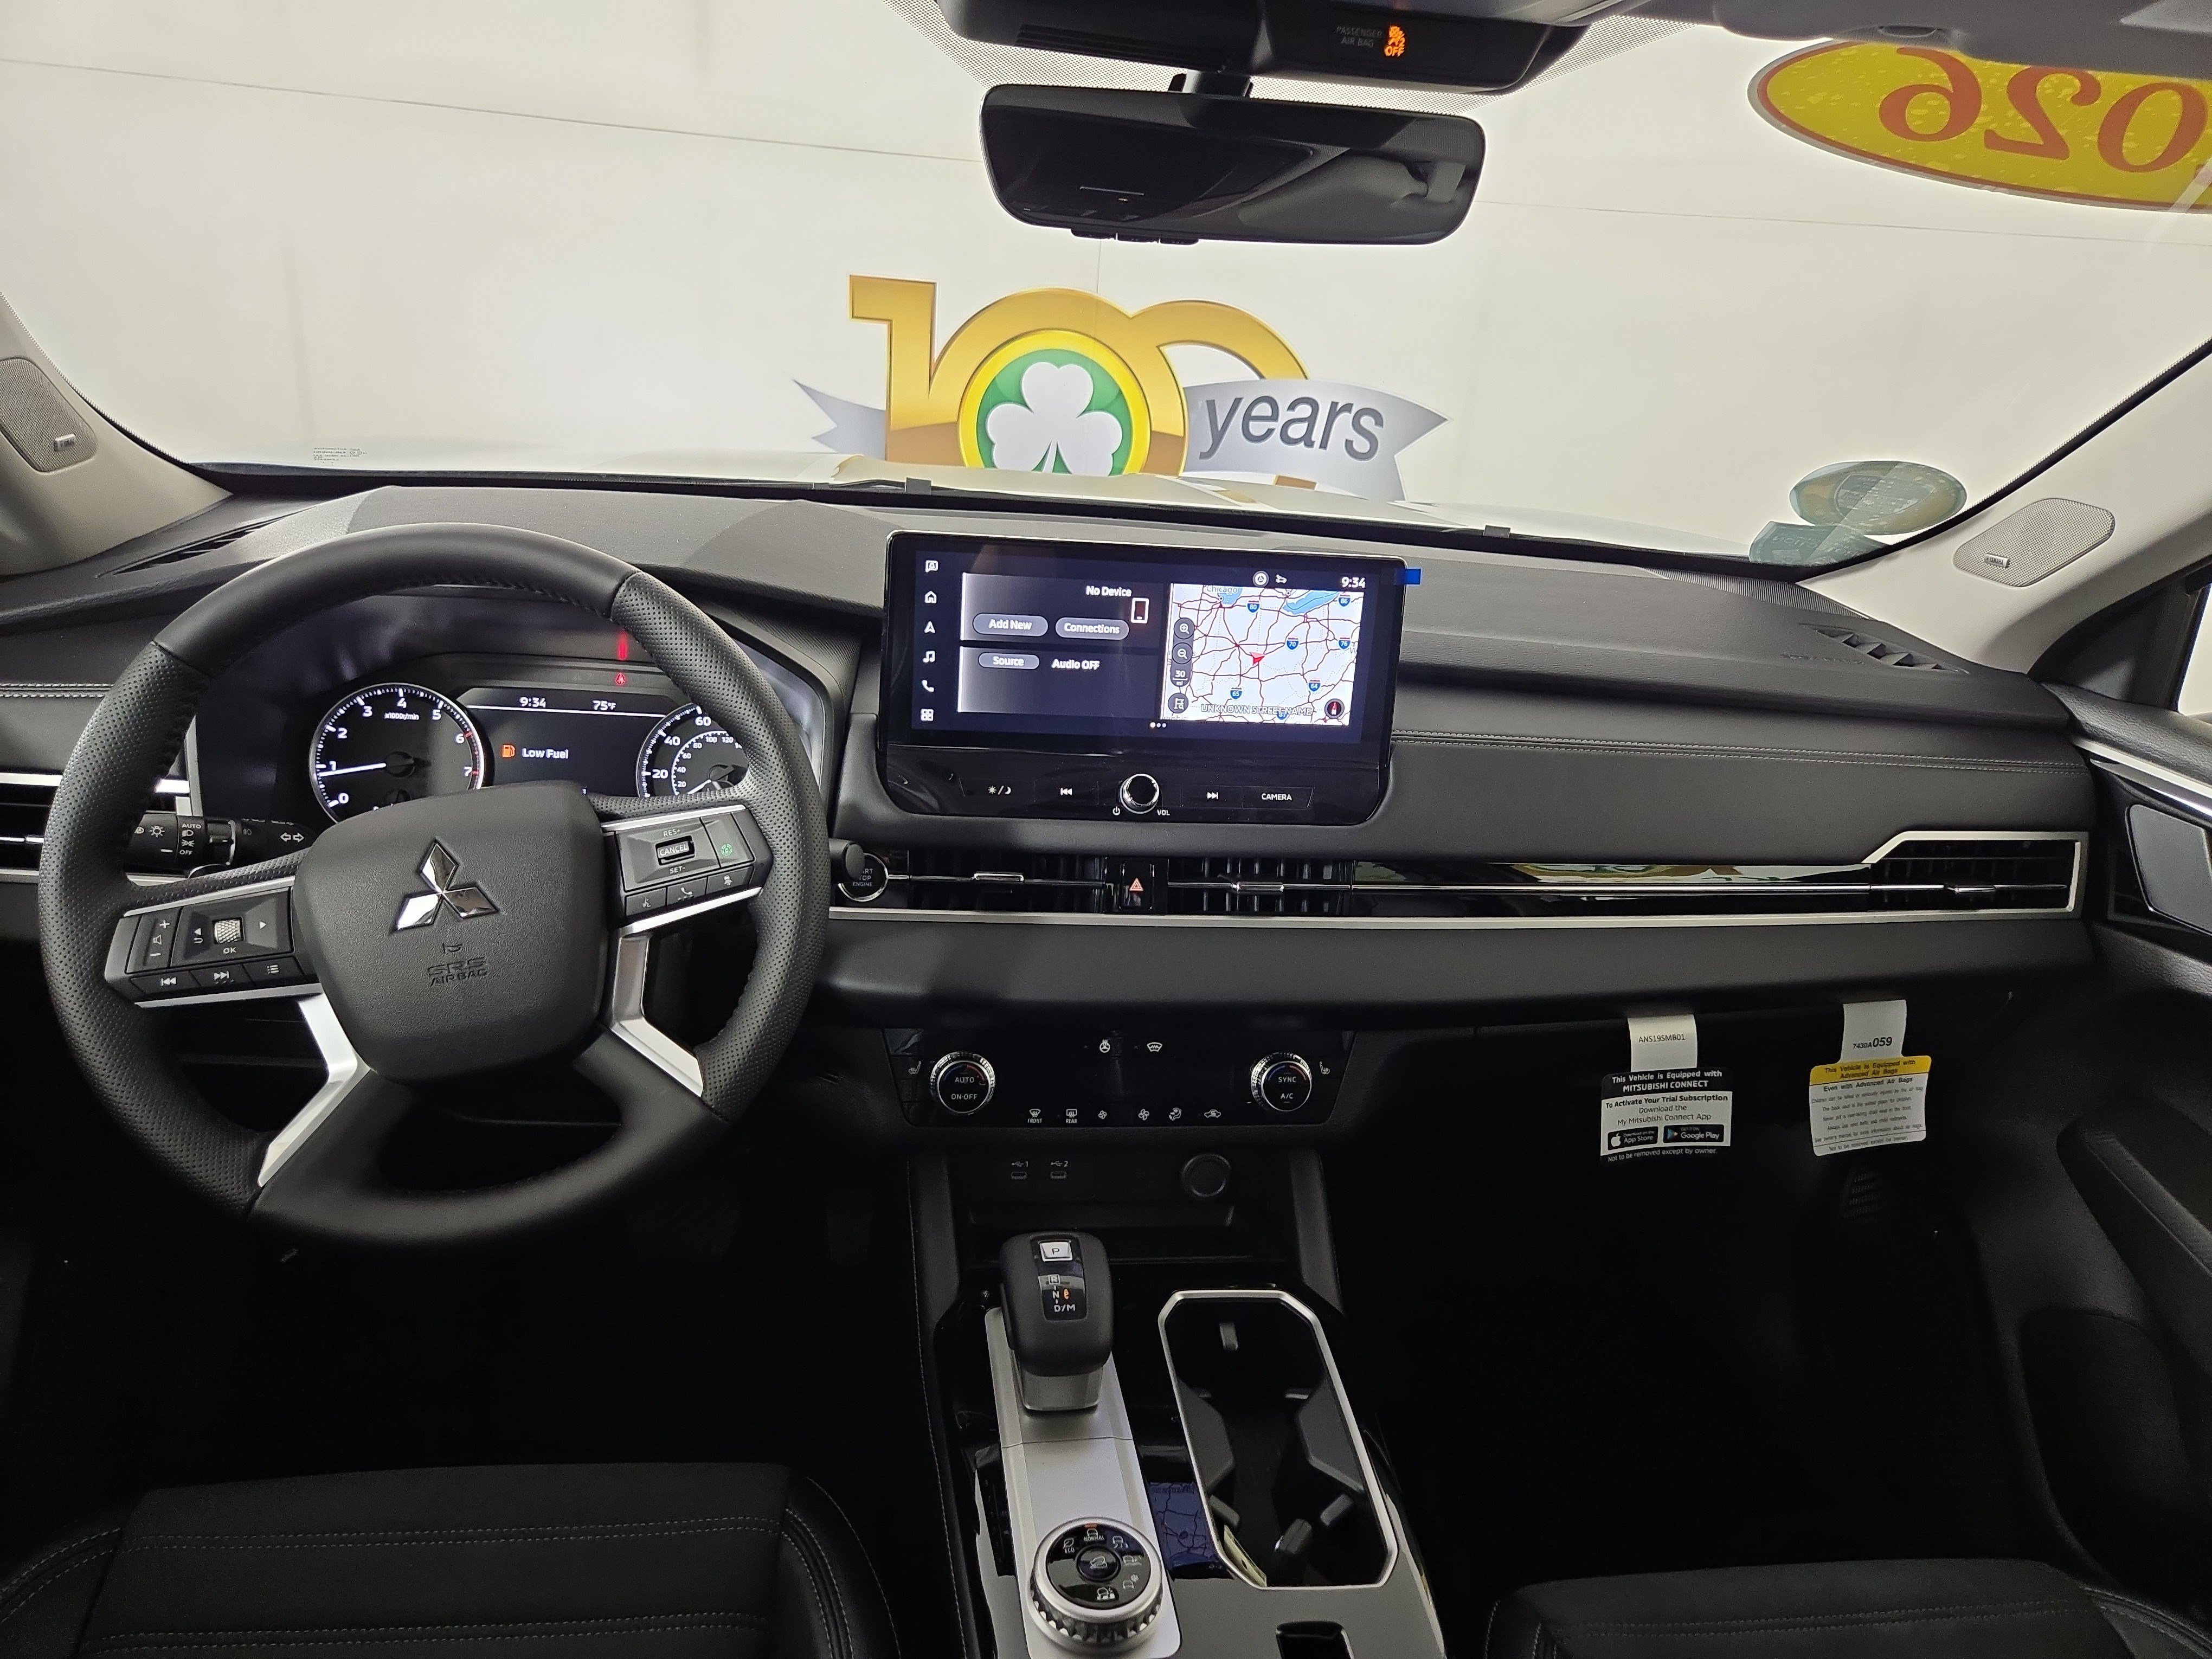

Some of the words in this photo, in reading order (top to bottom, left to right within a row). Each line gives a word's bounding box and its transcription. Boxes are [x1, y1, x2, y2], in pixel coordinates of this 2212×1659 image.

[1341, 36, 1355, 45] AIR
[1358, 37, 1374, 47] BAG
[1384, 46, 1405, 57] OFF
[1199, 390, 1386, 462] years
[1341, 576, 1366, 589] 9:34
[1086, 586, 1100, 596] No
[1102, 586, 1132, 597] Device
[1206, 586, 1238, 594] Chicago
[988, 619, 1009, 629] Add
[1010, 620, 1032, 631] New
[1064, 623, 1120, 634] Connections
[993, 657, 1024, 666] Source
[1052, 659, 1080, 670] Audio
[1082, 660, 1100, 670] OFF
[397, 697, 407, 708] 4
[519, 697, 546, 708] 9:34
[593, 700, 616, 710] 75°F
[363, 705, 372, 717] 3
[432, 709, 441, 720] 5
[1201, 704, 1250, 713] UNKNOWN
[1251, 705, 1284, 715] STREET
[1285, 706, 1312, 716] NAME
[384, 712, 420, 721] x1000r/min
[695, 716, 711, 726] 60
[337, 727, 348, 738] 2
[455, 734, 465, 743] 6
[664, 736, 680, 746] 40
[522, 748, 545, 758] Low
[546, 749, 569, 759] Fuel
[329, 760, 337, 771] 1
[464, 767, 472, 777] 7
[652, 769, 668, 779] 20
[338, 793, 349, 803] 0
[1261, 793, 1293, 801] CAMERA
[663, 828, 680, 837] RES+
[659, 844, 689, 857] CANCEL
[427, 957, 487, 976] SRS
[429, 968, 487, 987] AIRBAG
[1873, 1060, 1900, 1069] Equipped
[1667, 1070, 1701, 1079] Equipped
[1840, 1071, 1869, 1079] Advanced
[1623, 1082, 1668, 1093] MITSUBISHI
[1670, 1080, 1708, 1089] CONNECT
[1615, 1099, 1642, 1108] Activate
[1680, 1094, 1728, 1102] Subscription
[1638, 1105, 1673, 1114] Download
[1629, 1115, 1663, 1124] Mitsubishi
[1664, 1114, 1694, 1122] Connect
[1681, 1132, 1705, 1140] Google
[1706, 1131, 1720, 1140] Play
[1634, 1148, 1661, 1157] removed
[1052, 1290, 1060, 1299] N
[1054, 1304, 1076, 1313] D/M
